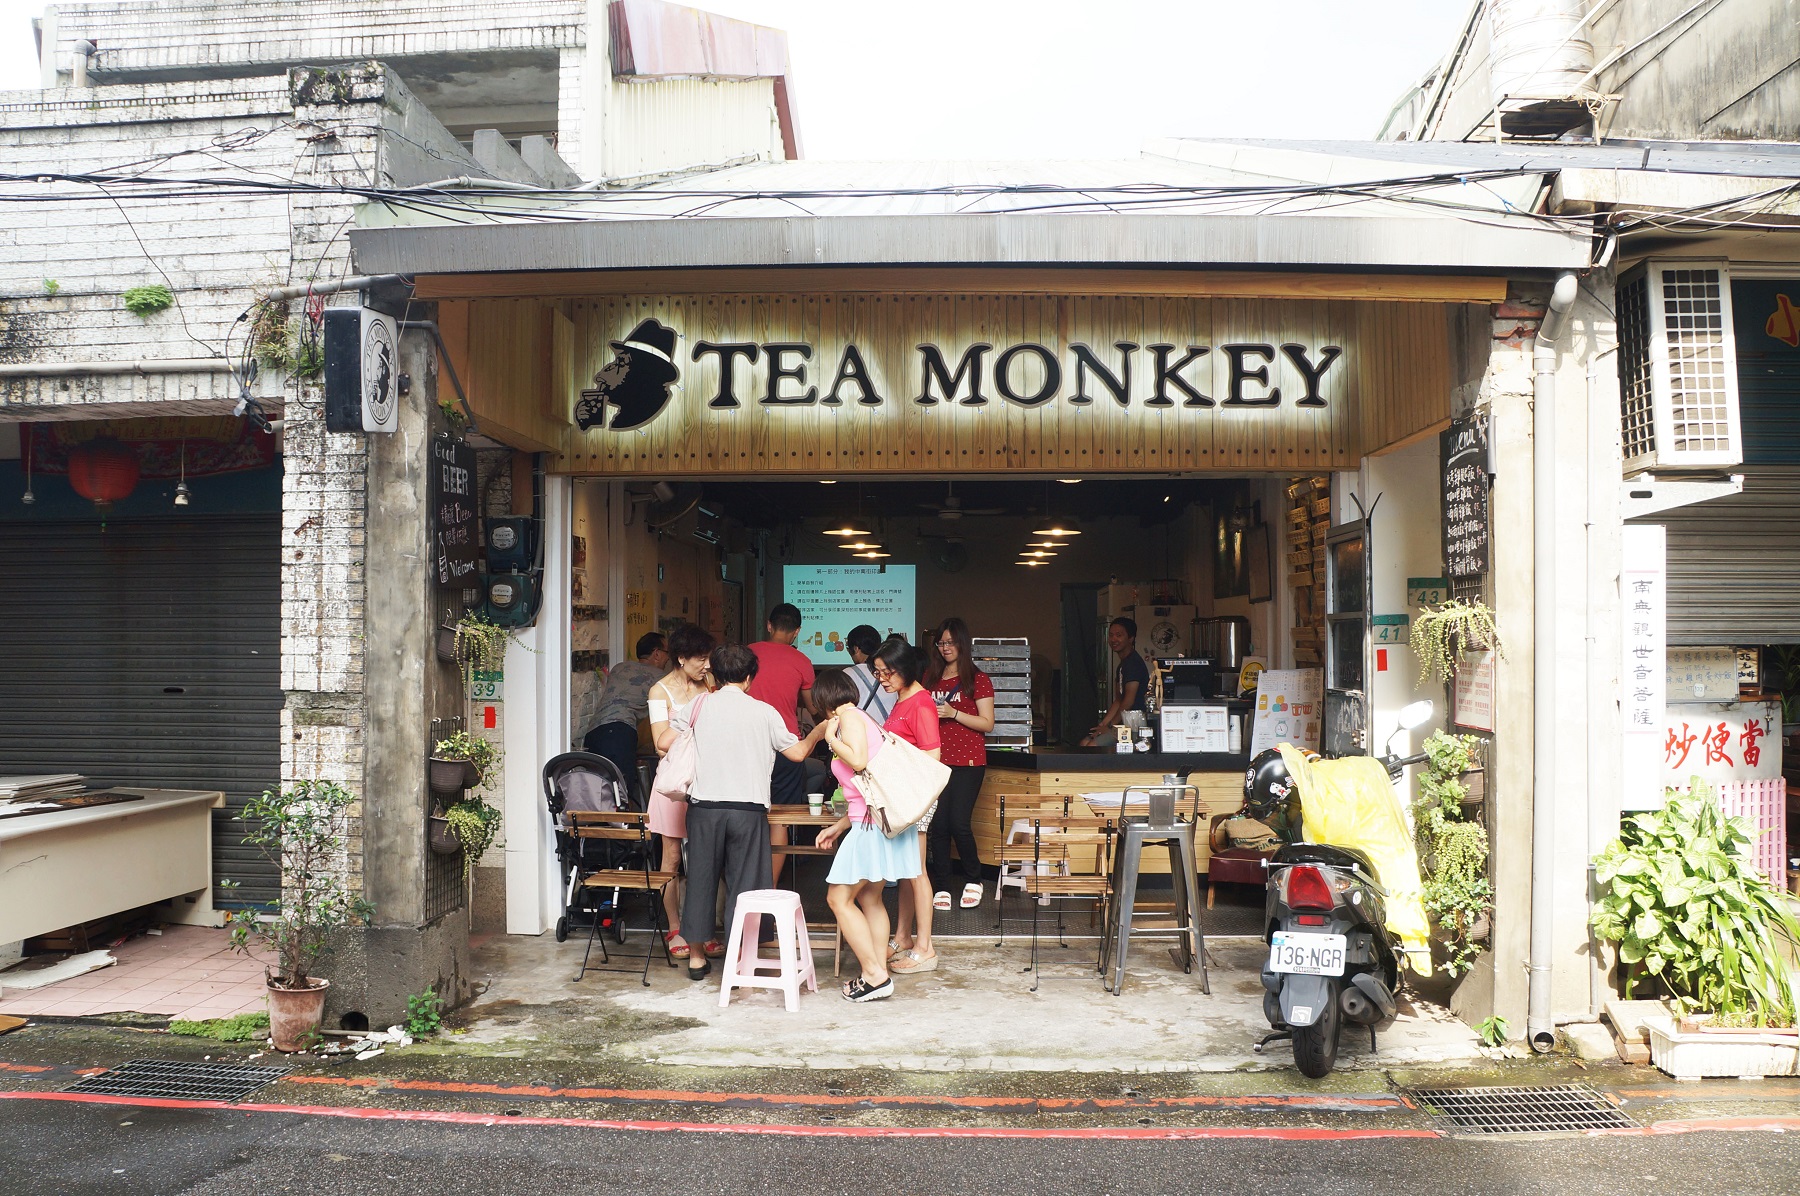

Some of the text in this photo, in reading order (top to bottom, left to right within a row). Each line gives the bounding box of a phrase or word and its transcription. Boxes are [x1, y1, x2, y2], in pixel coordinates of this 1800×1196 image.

[691, 341, 1343, 409] TEA MONKEY
[442, 464, 468, 496] BEER
[449, 560, 475, 578] Welcome
[1417, 590, 1439, 604] 43
[1379, 627, 1400, 641] 41
[1632, 580, 1654, 725] 南無觀世音菩薩
[1740, 653, 1751, 661] 35
[473, 683, 496, 697] 39
[1665, 718, 1764, 770] 炒便當
